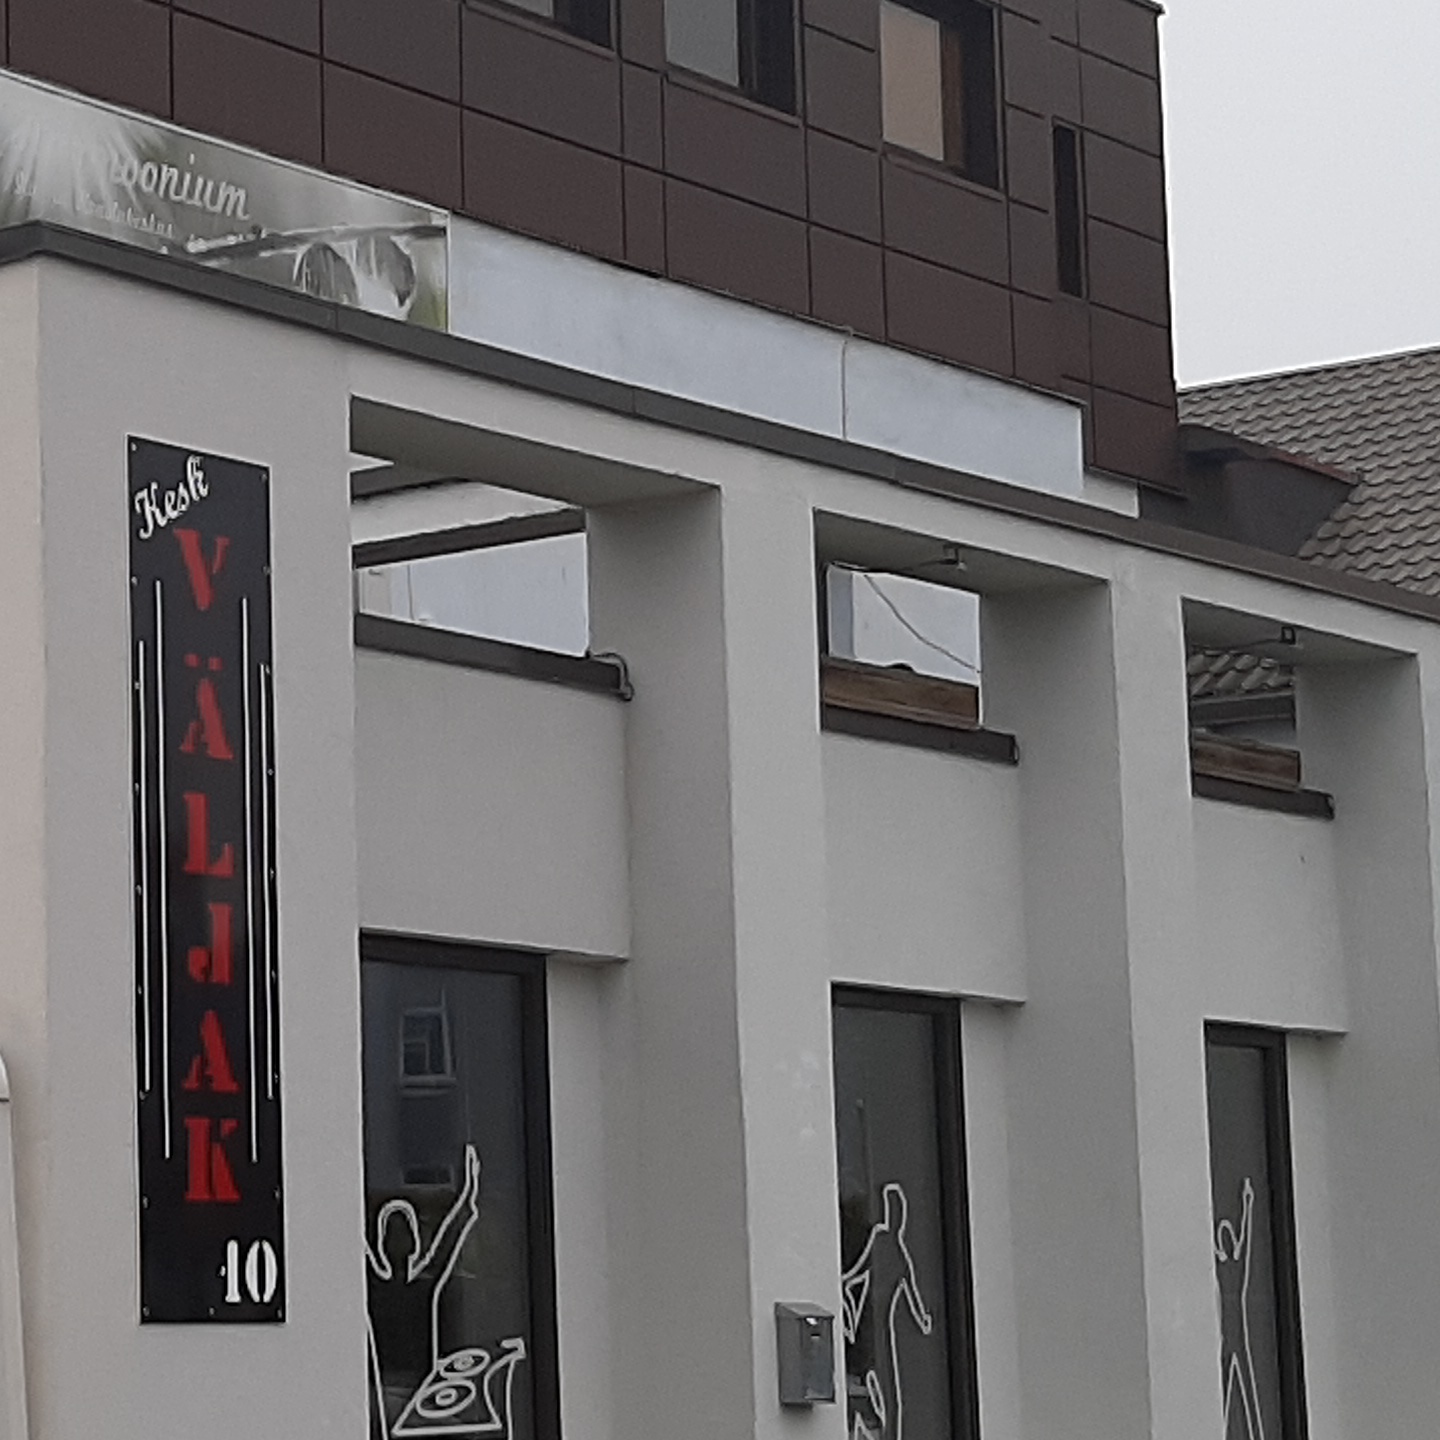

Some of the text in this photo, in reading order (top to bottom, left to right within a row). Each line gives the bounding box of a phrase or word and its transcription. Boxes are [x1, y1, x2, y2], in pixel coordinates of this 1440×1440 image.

[133, 454, 210, 540] Kesk
[172, 526, 243, 1204] VÄLJAK
[219, 1238, 279, 1304] 10
